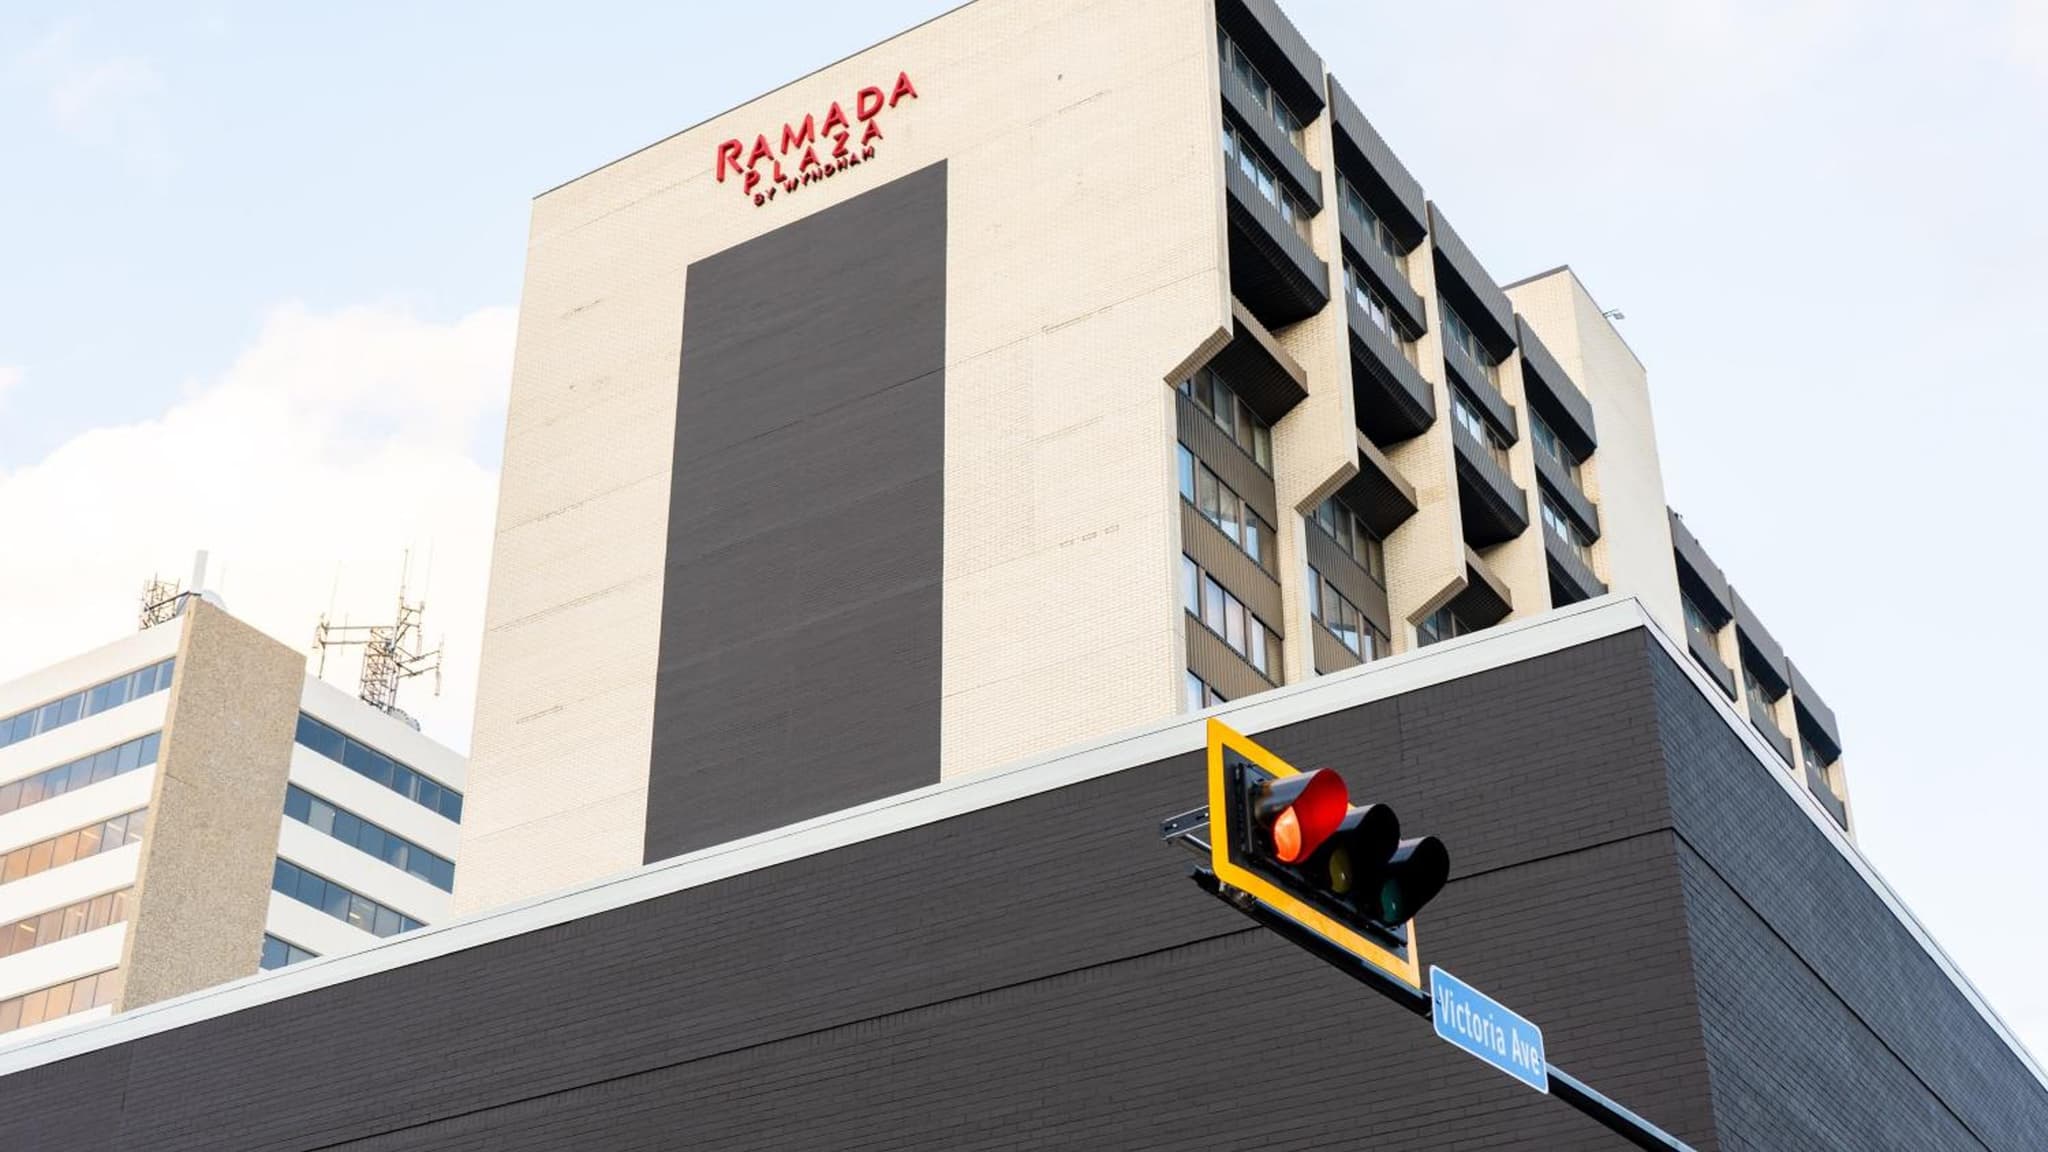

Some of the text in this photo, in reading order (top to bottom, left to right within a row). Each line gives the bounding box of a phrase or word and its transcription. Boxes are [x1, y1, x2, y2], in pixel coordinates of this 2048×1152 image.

[716, 71, 918, 183] RAMADA
[743, 118, 883, 195] PLAZA
[753, 146, 875, 206] BY WYNDHAM
[1438, 984, 1540, 1075] Victoria Ave
